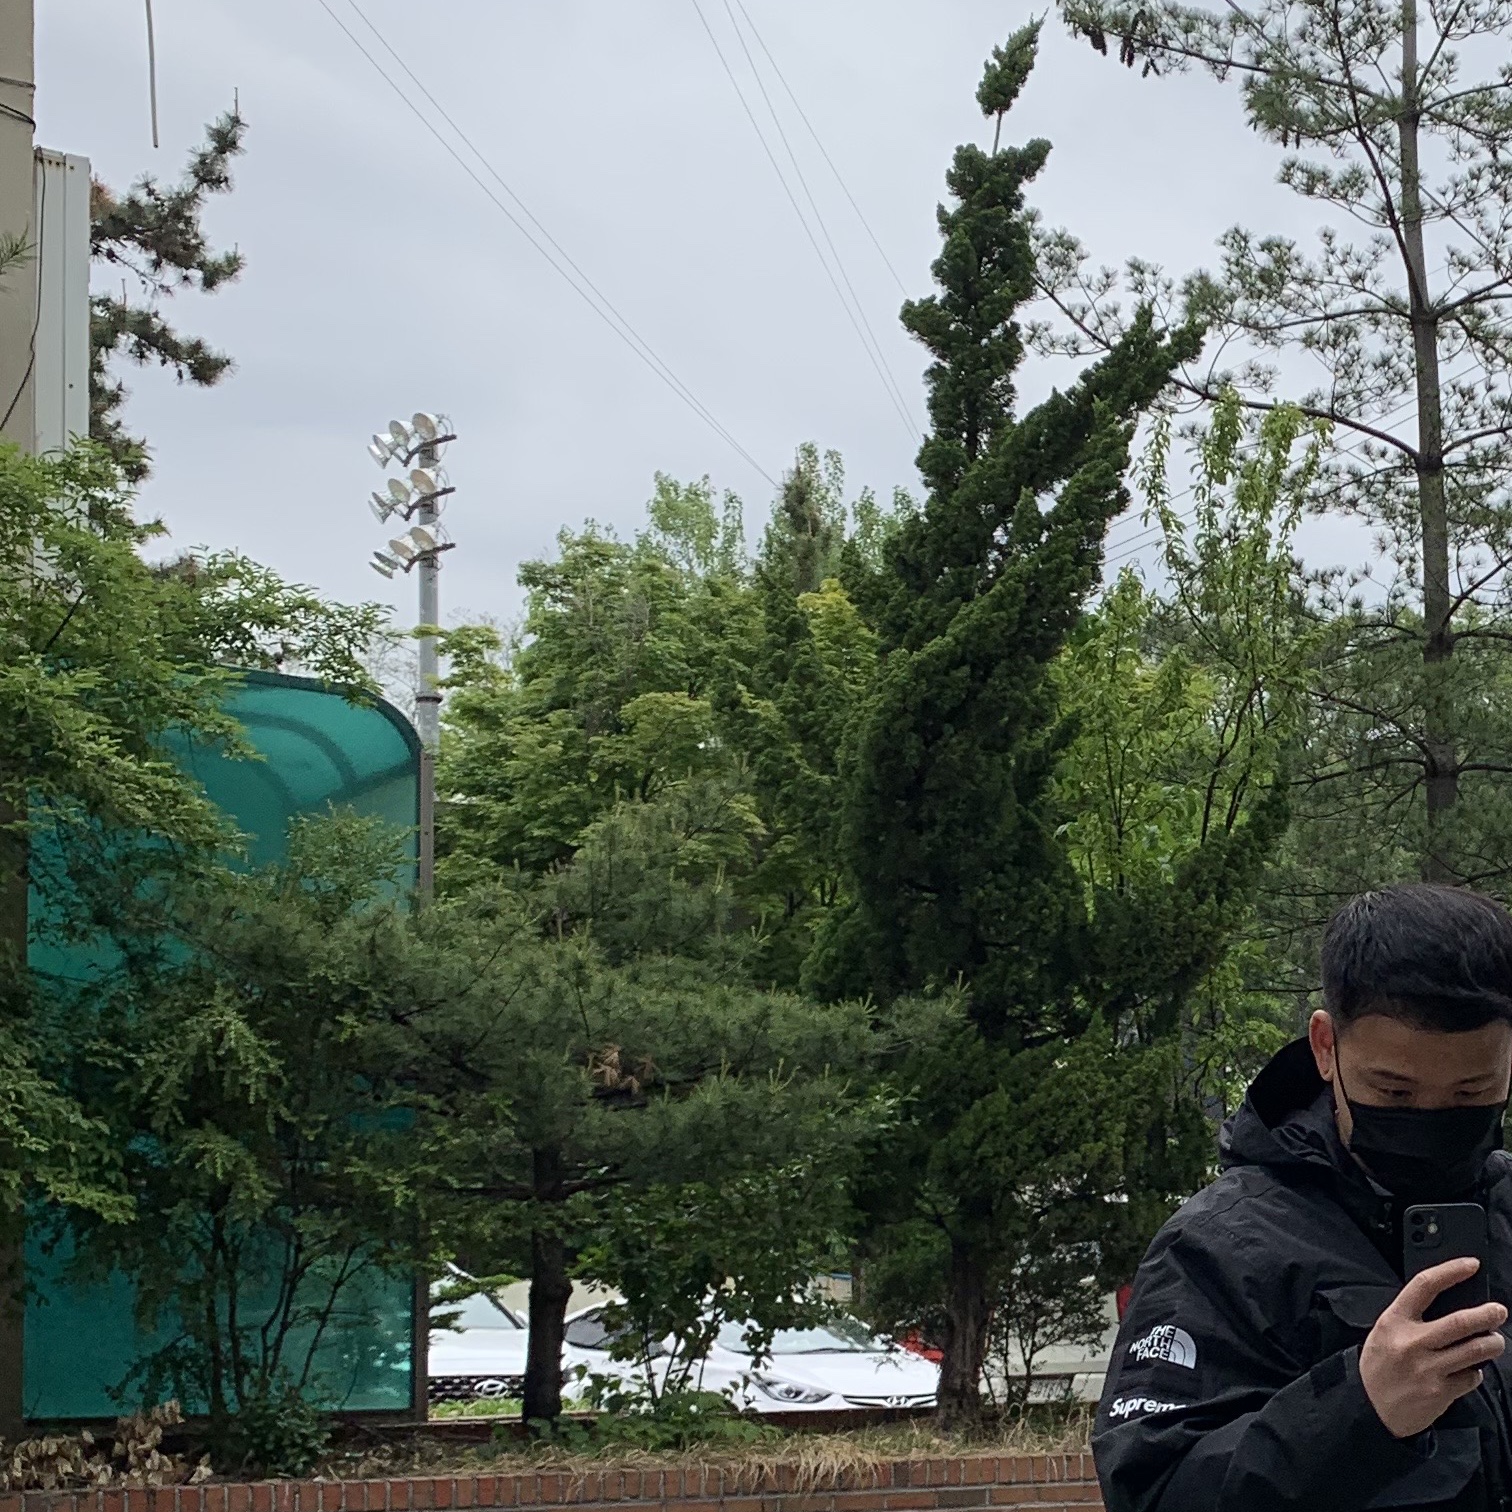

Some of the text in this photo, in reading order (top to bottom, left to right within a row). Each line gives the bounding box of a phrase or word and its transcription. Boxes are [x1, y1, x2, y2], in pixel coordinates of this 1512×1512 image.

[1150, 1325, 1176, 1339] THE
[1129, 1334, 1172, 1354] NORTH
[1136, 1346, 1170, 1361] FACE
[1109, 1397, 1187, 1419] Suprem
